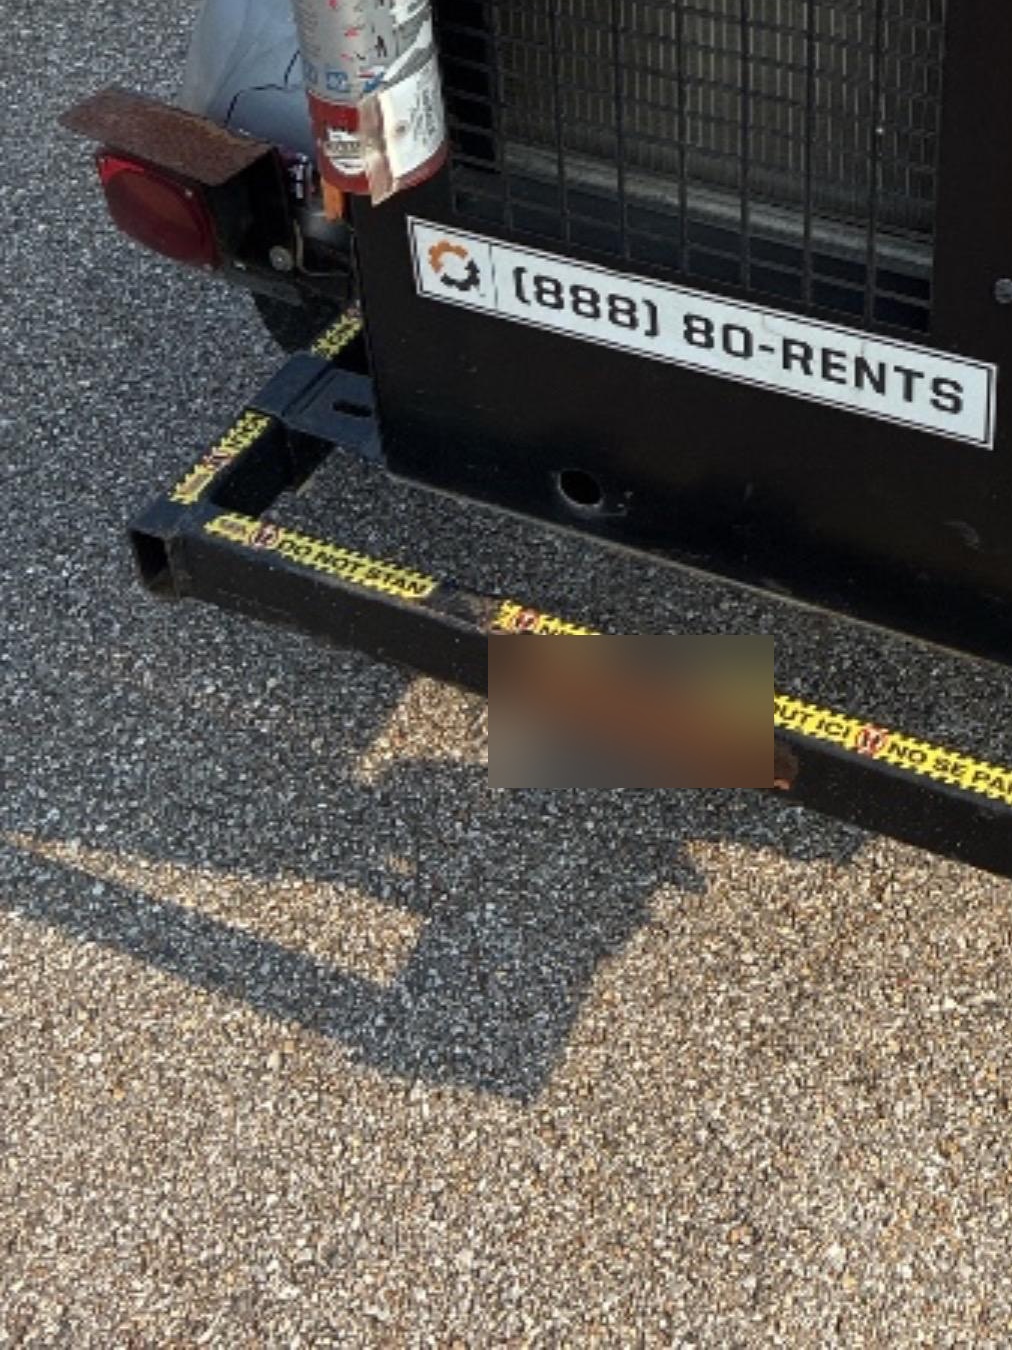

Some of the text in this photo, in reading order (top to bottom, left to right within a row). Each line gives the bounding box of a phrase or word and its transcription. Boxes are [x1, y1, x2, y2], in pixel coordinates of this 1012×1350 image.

[513, 265, 964, 416] (888) 80-RENTS
[277, 539, 313, 558] DO
[314, 550, 363, 574] NOT
[888, 744, 928, 765] NO
[933, 756, 968, 777] SE
